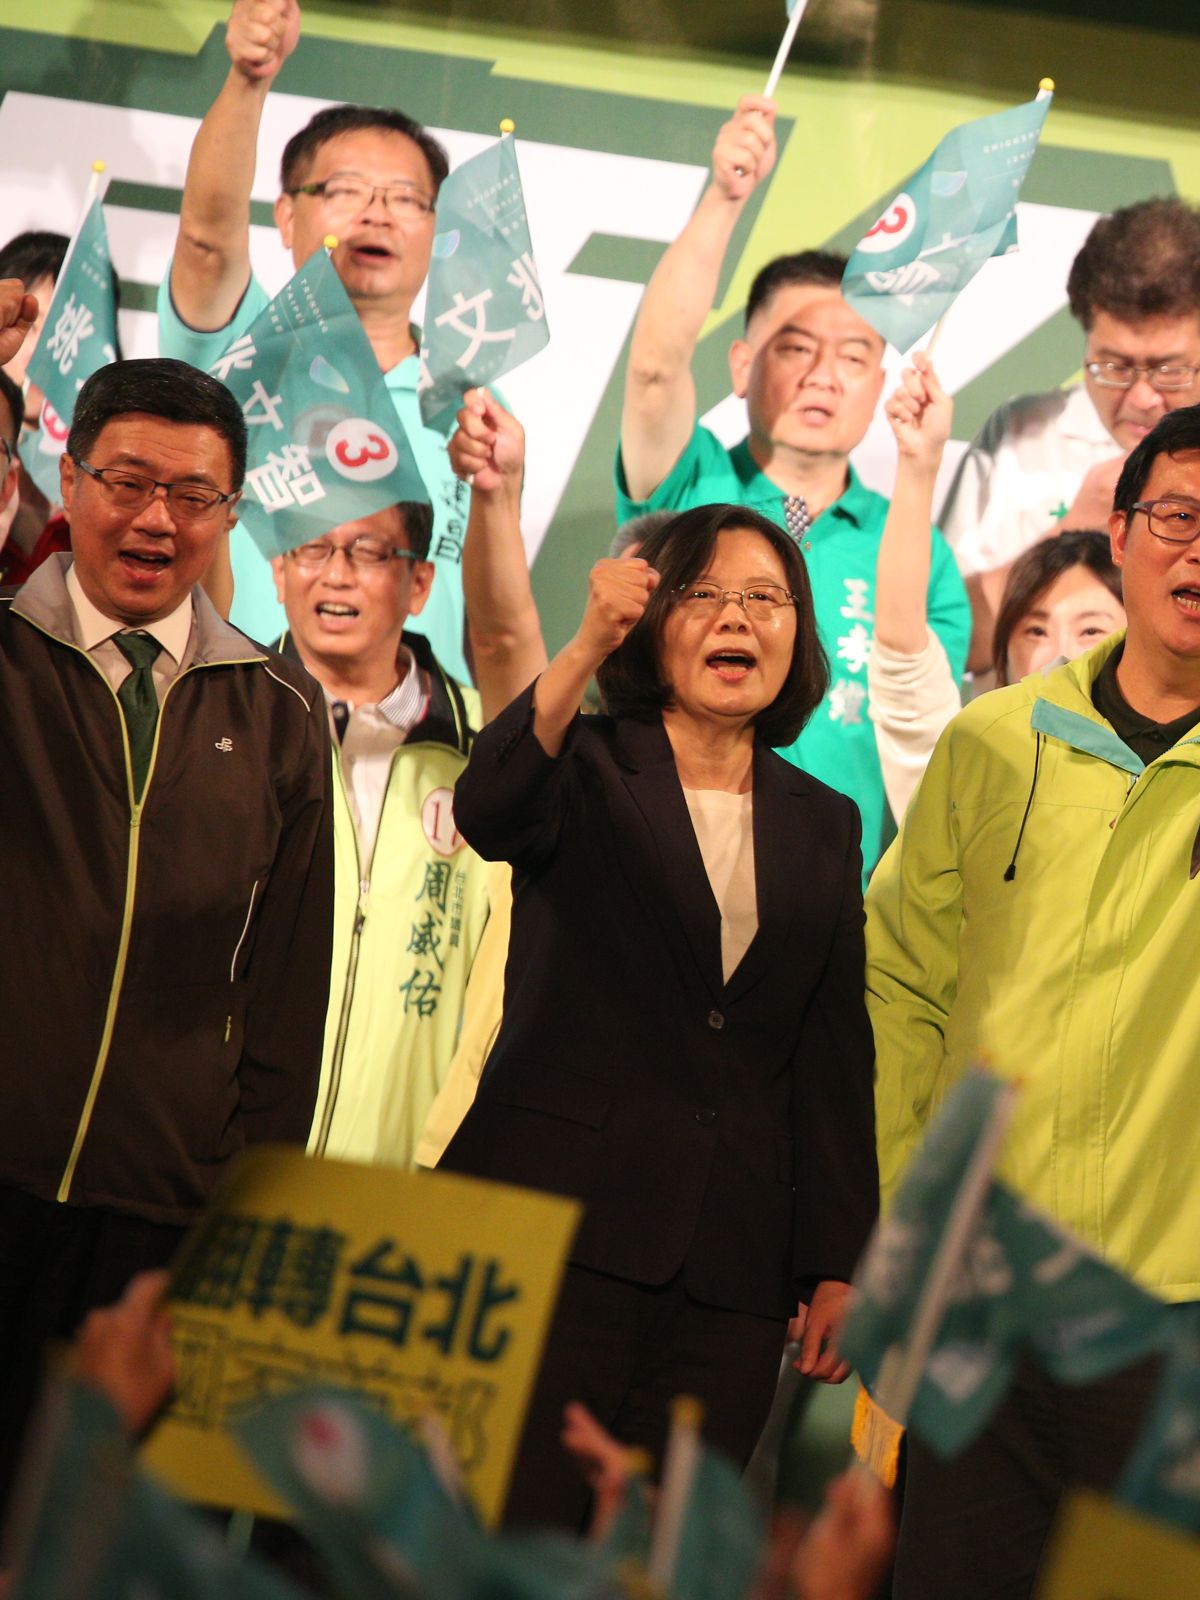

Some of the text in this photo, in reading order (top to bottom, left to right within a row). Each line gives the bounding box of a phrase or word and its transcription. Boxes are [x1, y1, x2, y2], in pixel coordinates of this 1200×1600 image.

[334, 433, 391, 469] 3
[431, 800, 459, 846] 1
[399, 861, 451, 1019] 周威佑
